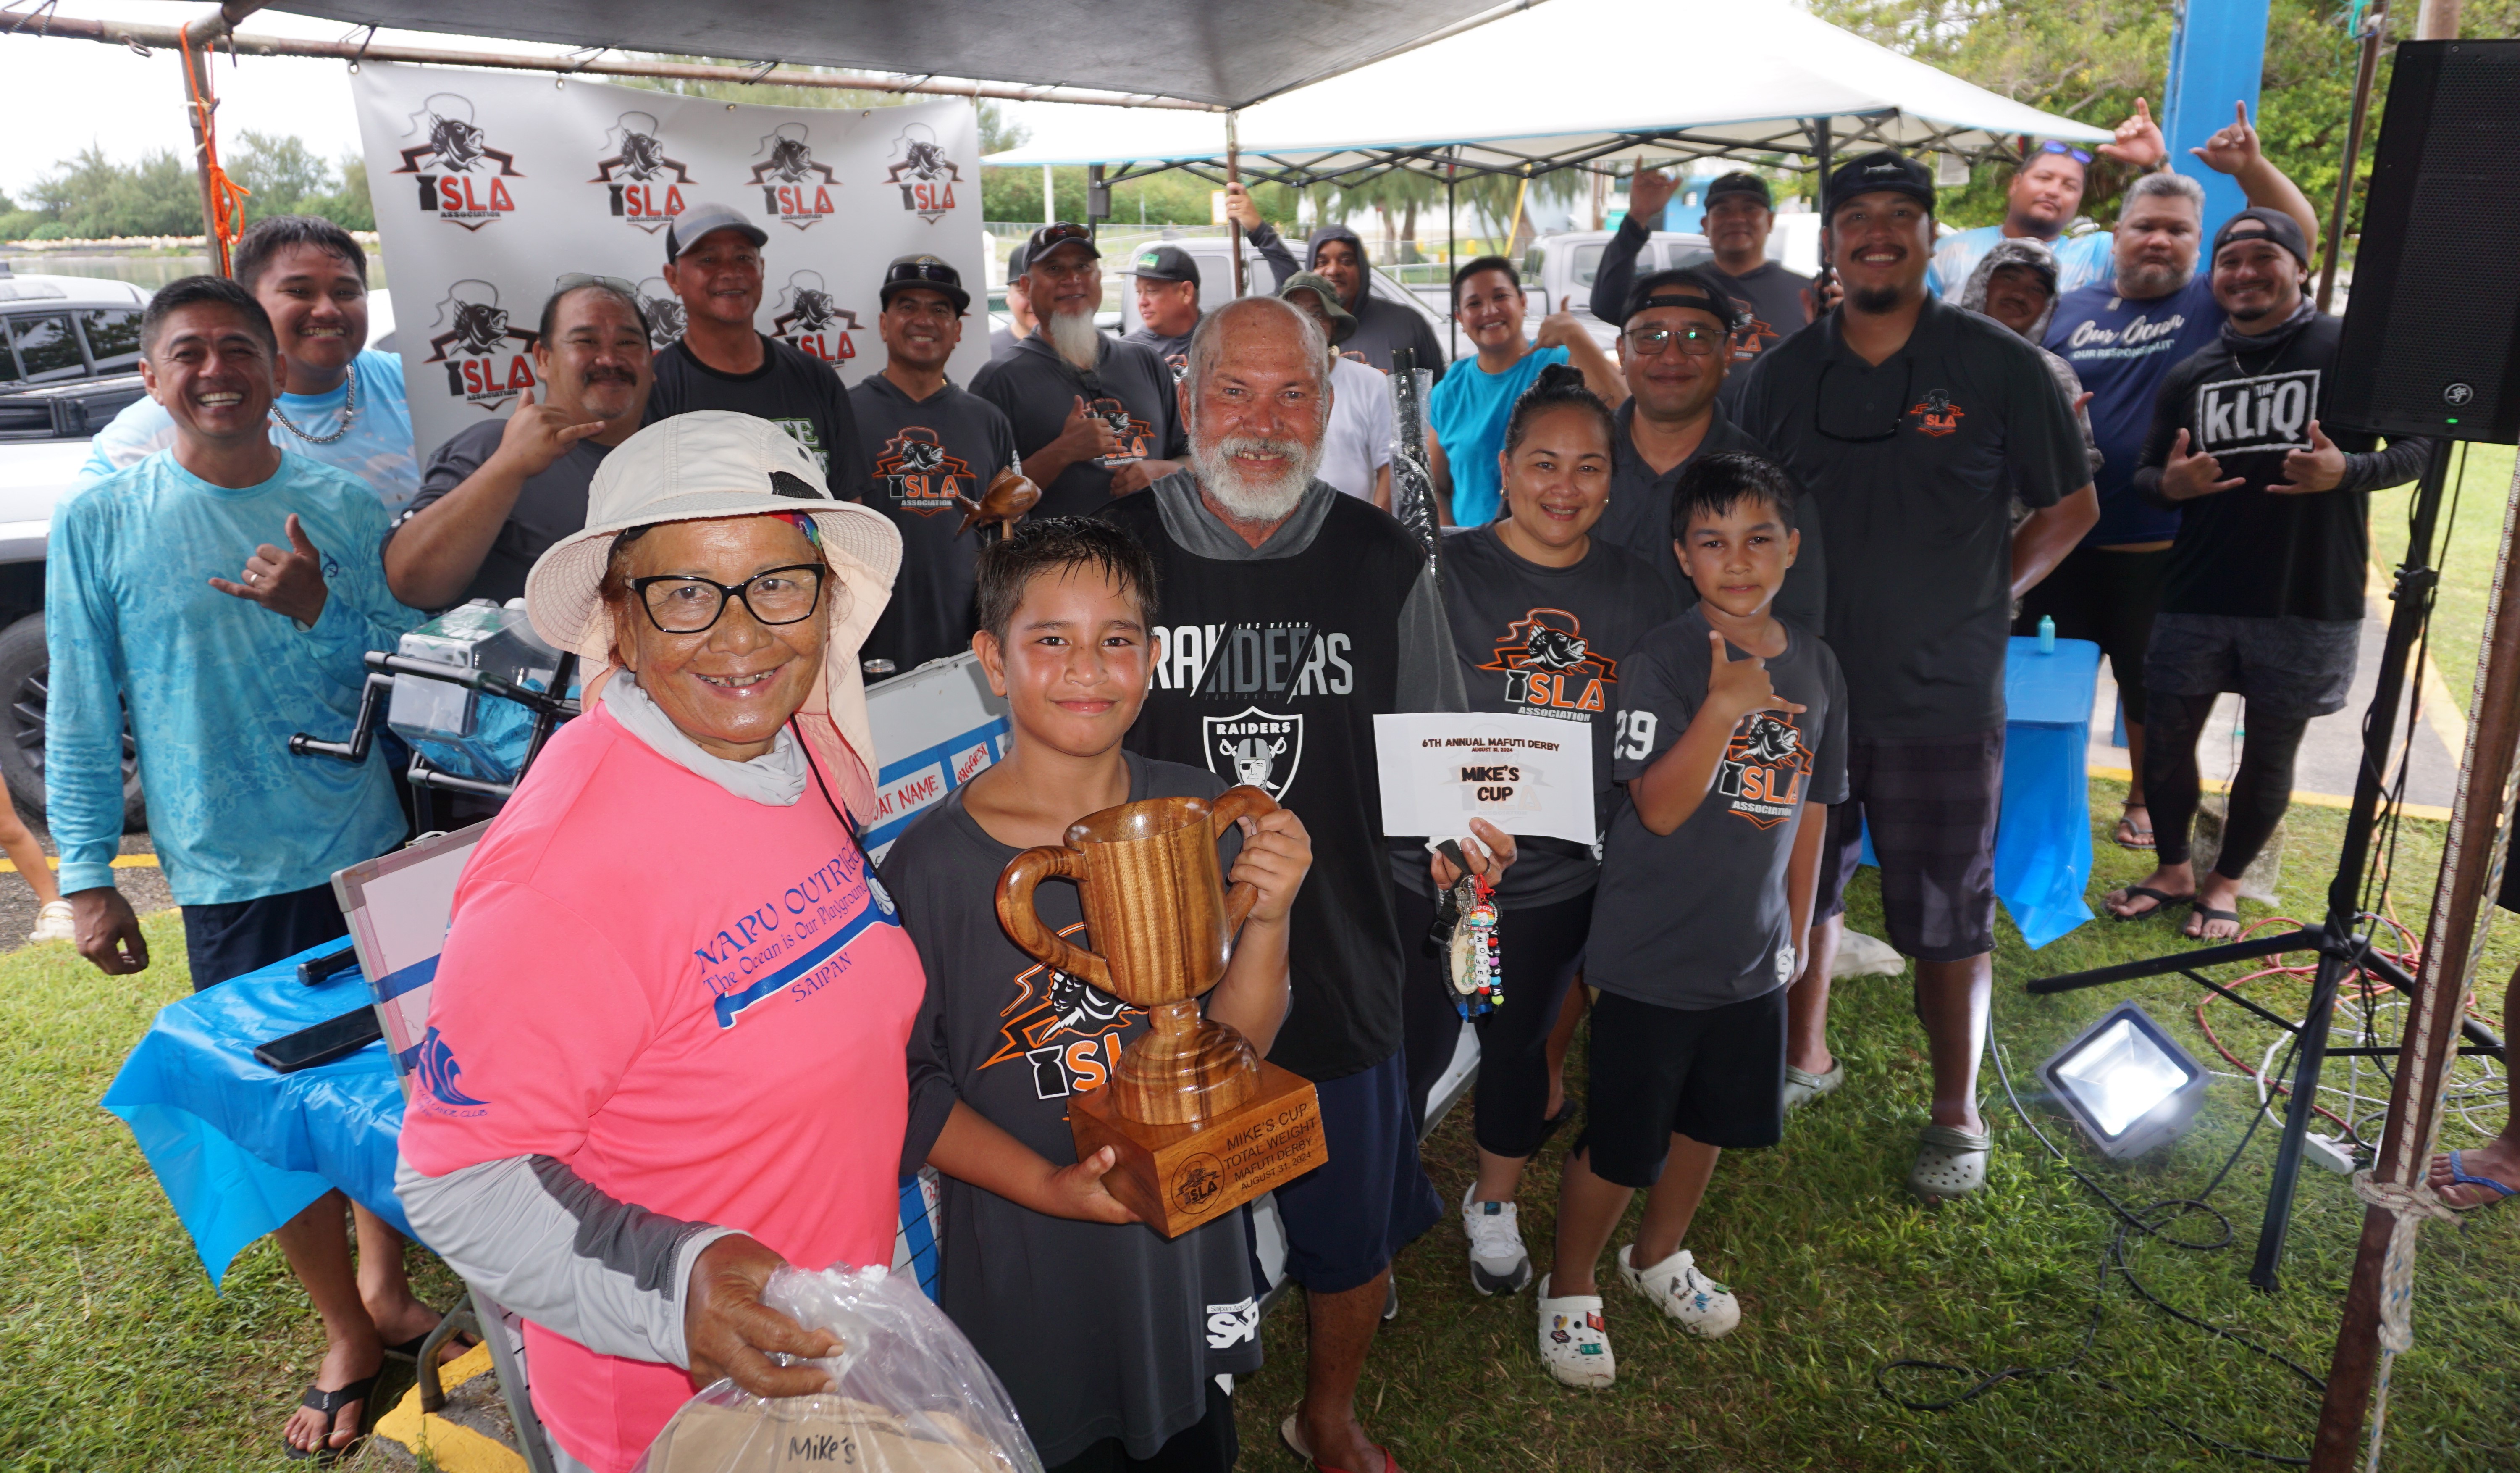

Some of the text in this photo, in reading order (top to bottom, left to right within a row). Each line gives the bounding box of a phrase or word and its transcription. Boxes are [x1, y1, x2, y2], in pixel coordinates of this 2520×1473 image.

[416, 174, 515, 211] ISLA
[608, 184, 686, 216] ISLA
[762, 185, 834, 214] ISLA
[899, 182, 955, 210] ISLA
[2068, 314, 2185, 349] Our Ocean
[444, 355, 536, 396] ISLA
[2255, 381, 2276, 397] THE
[887, 475, 961, 498] ISLA
[1505, 669, 1606, 712] ISLA
[1216, 721, 1292, 735] RAIDERS
[1518, 706, 1591, 722] ASSOCIATION
[957, 742, 988, 783] BIGGEST
[1422, 738, 1560, 752] 6TH ANNUAL MAFUTI DERBY
[1462, 765, 1520, 782] MIKE'S
[1719, 759, 1799, 805] ISLA
[898, 774, 939, 809] NAME
[1477, 786, 1514, 801] CUP
[1732, 800, 1792, 817] ASSOCIATION
[694, 837, 860, 975] NAPU OUTRIGG
[704, 878, 869, 996] The Ocean is Our Playground
[792, 952, 853, 1002] SAIPAN
[1224, 1117, 1316, 1170] TOTAL WEIGHT
[1226, 1103, 1307, 1151] MIKE'S CUP
[1234, 1136, 1312, 1181] MAFUTI DERBY
[1241, 1168, 1276, 1191] AUGUST
[1292, 1151, 1311, 1167] 2024
